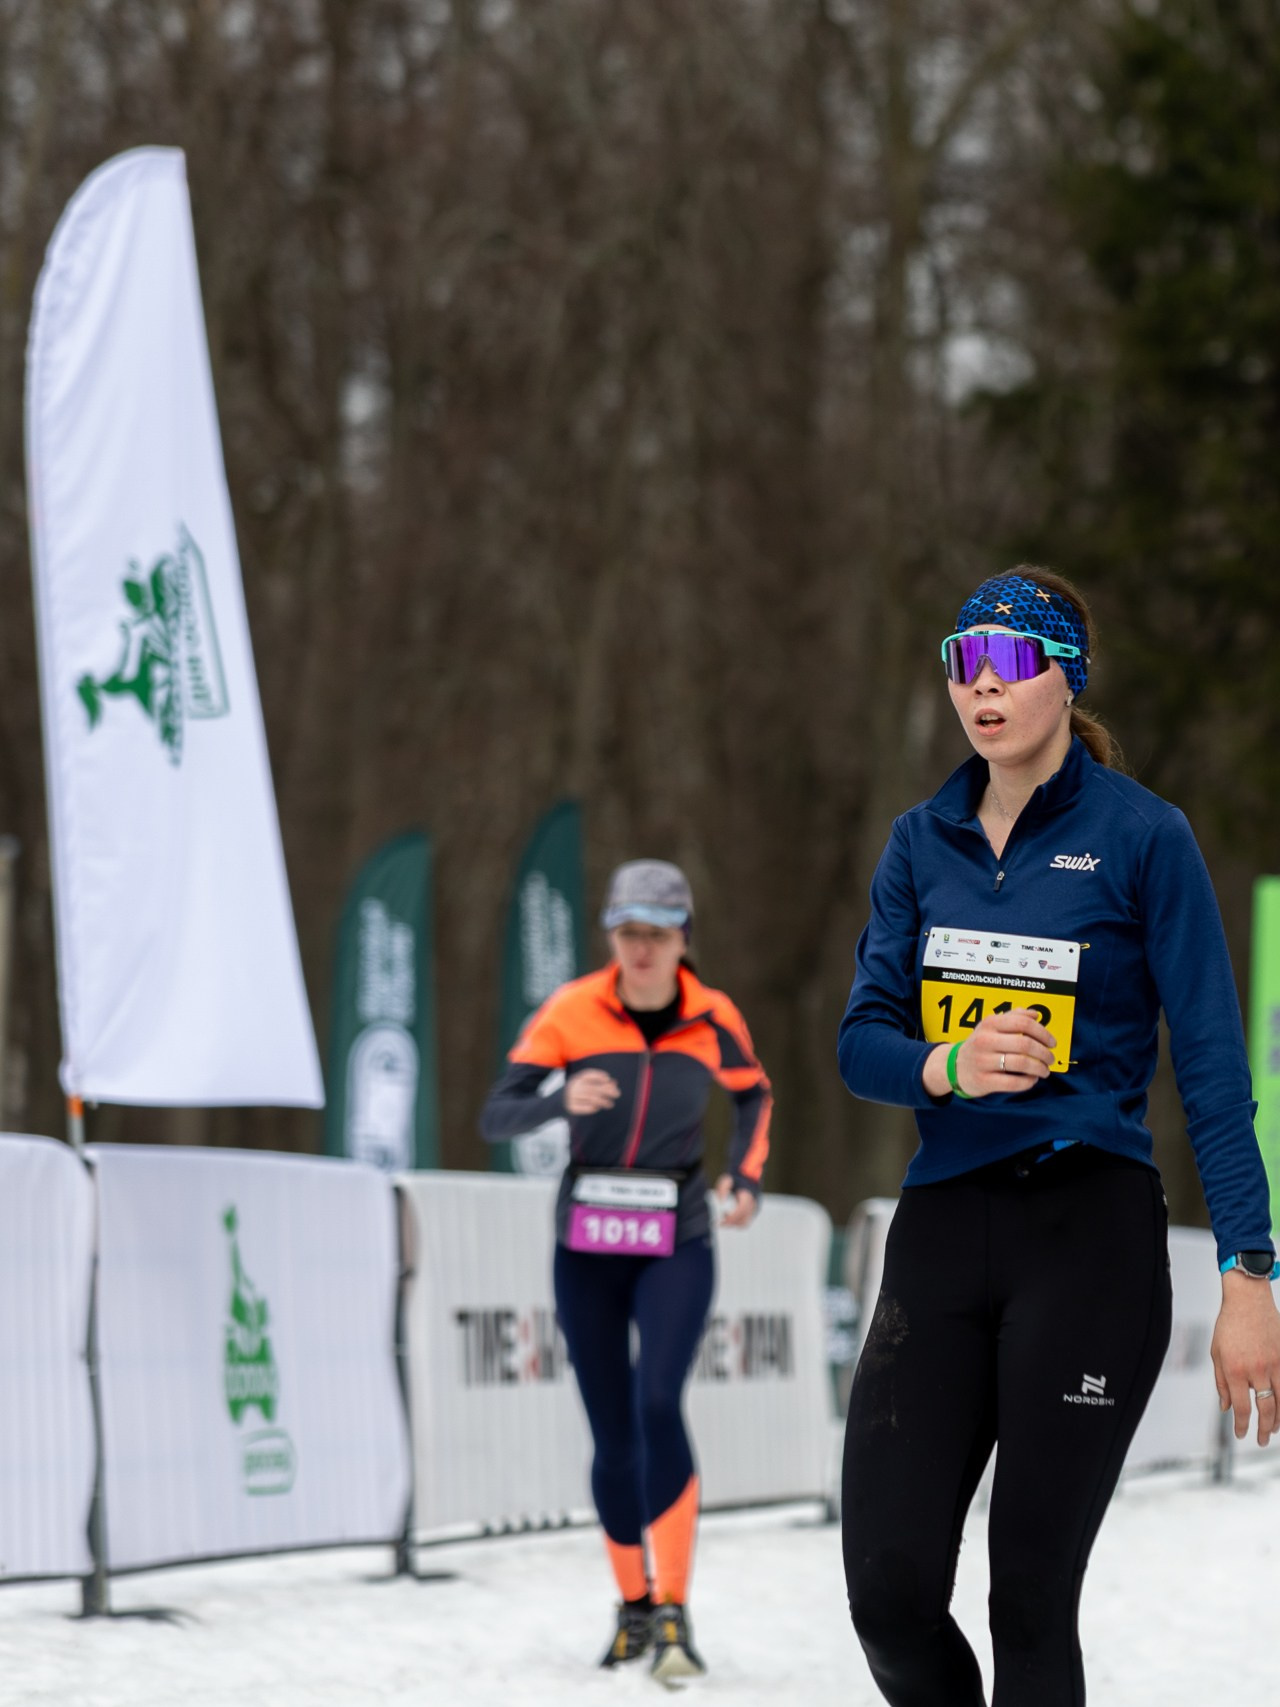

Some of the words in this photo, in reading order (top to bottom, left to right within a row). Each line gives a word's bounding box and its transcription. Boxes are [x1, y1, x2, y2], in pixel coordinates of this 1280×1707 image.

[941, 971, 1002, 985] ЗЕЛЕНОДОЛЬСКИЙ
[1003, 977, 1026, 988] ТРЕЙЛ
[1027, 980, 1046, 990] 2026
[583, 1214, 662, 1247] 1014
[1063, 1394, 1115, 1407] NORDSKI
